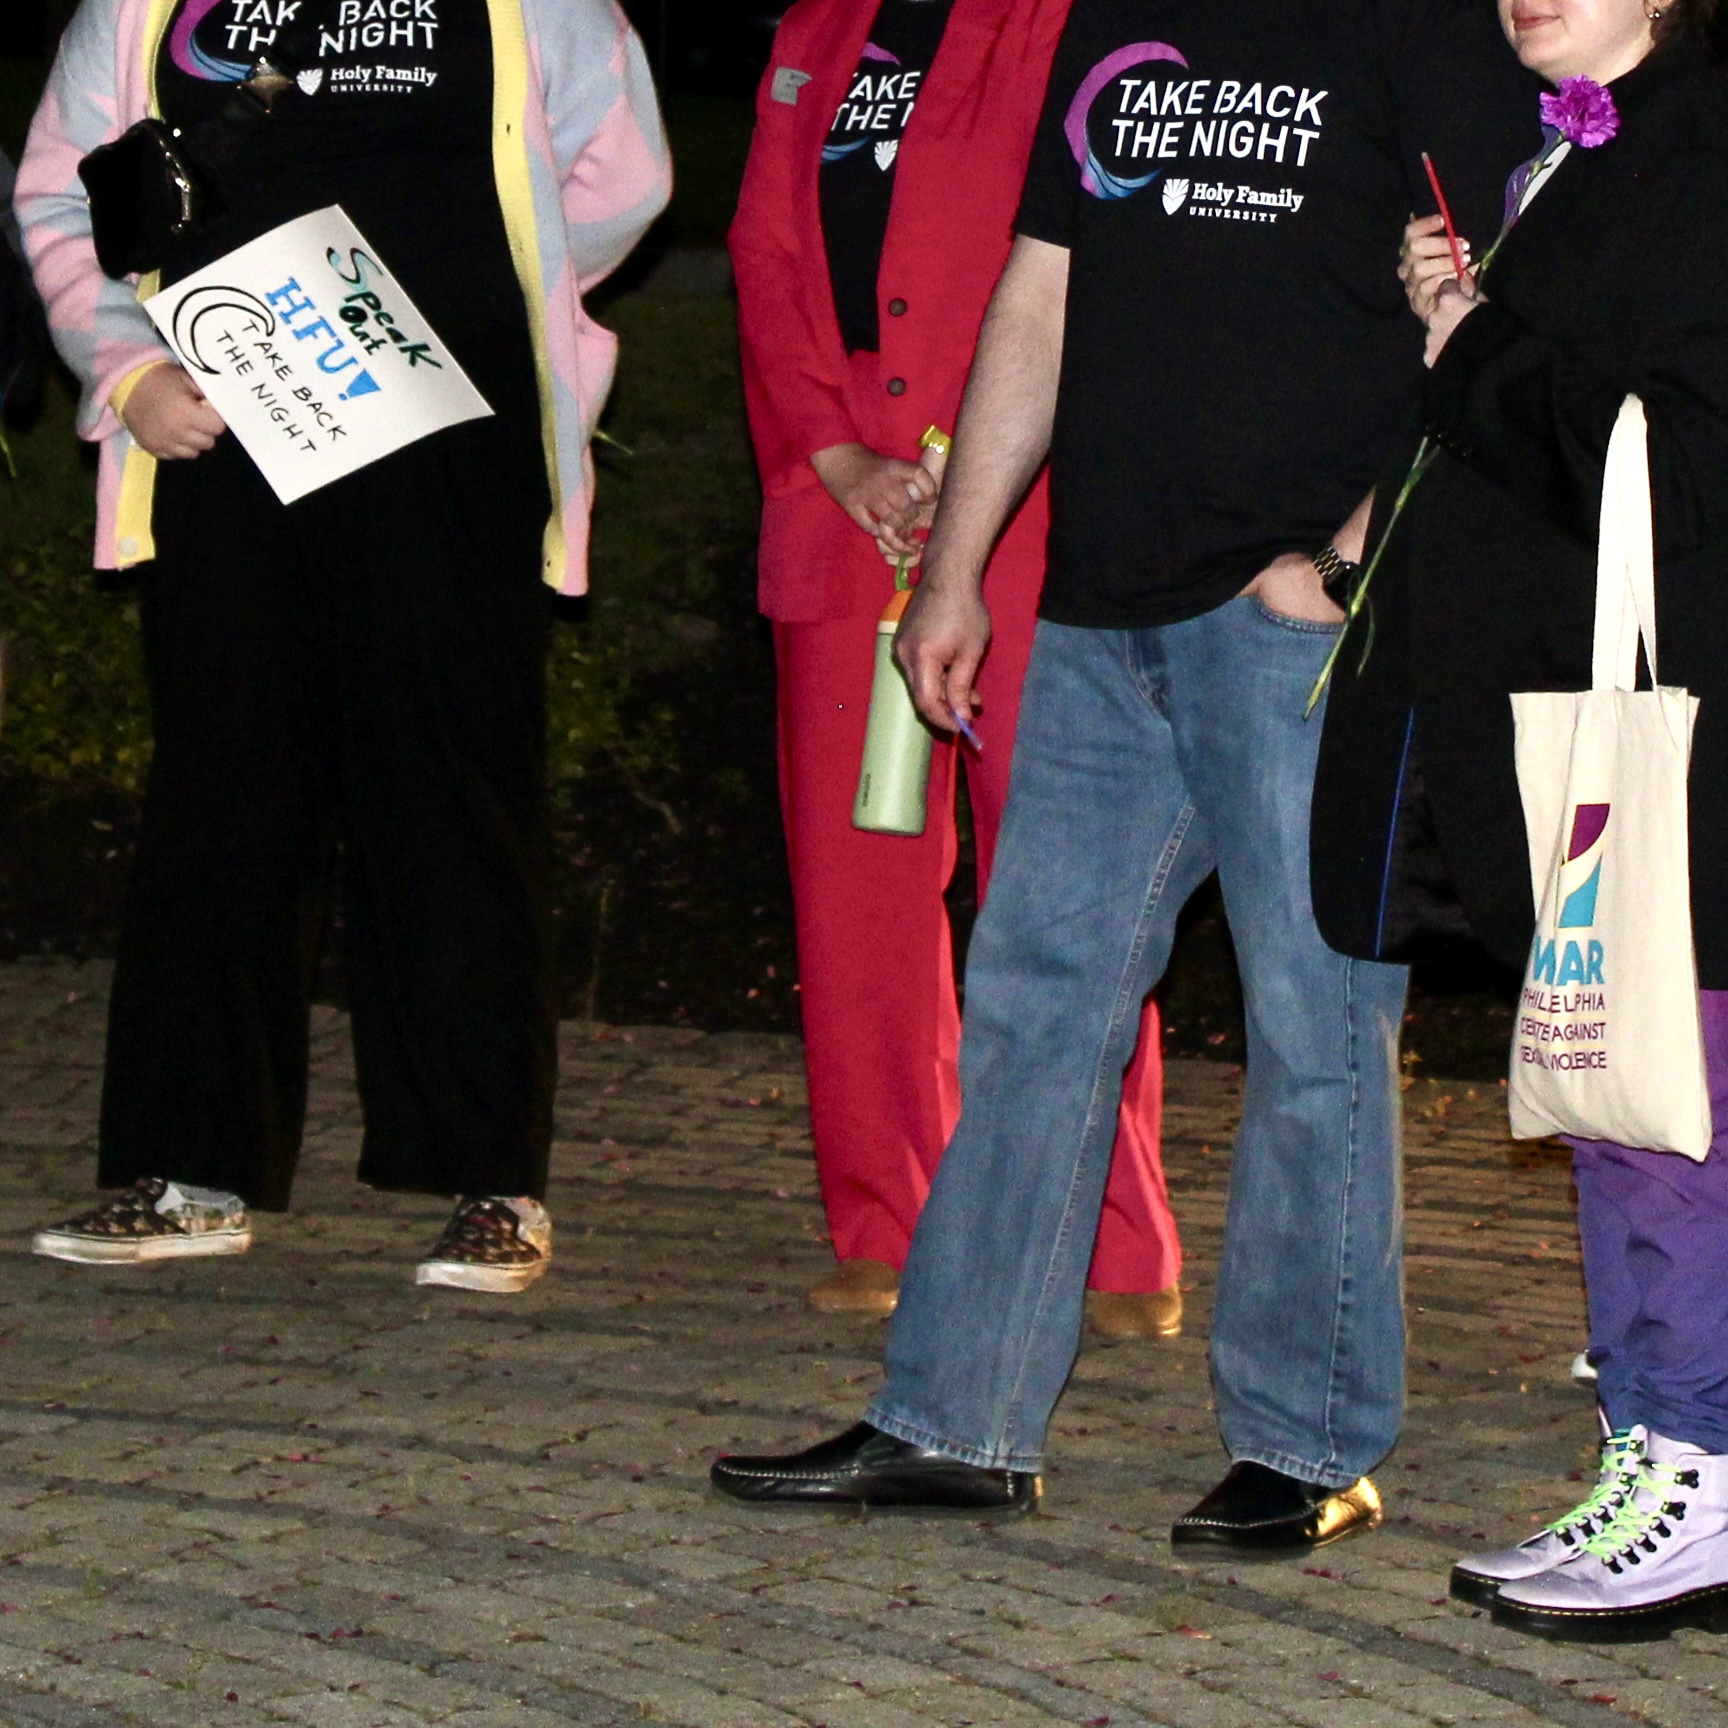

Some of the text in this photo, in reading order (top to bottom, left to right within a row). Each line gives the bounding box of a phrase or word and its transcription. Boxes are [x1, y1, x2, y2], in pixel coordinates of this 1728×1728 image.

[225, 21, 439, 57] TH NIGHT
[330, 65, 438, 87] Holy Family
[330, 84, 413, 94] UNIVERSITY
[848, 71, 922, 101] AKE
[1120, 79, 1328, 126] TAKE BACK
[1112, 119, 1320, 167] THE NIGHT
[1189, 206, 1277, 223] UNIVERSITY
[1192, 182, 1304, 212] Holy Family
[326, 246, 443, 370] Speak
[339, 305, 388, 356] Out
[265, 276, 382, 401] HFU!
[216, 329, 317, 453] THE NIGHT
[242, 319, 347, 442] TAKE BACK
